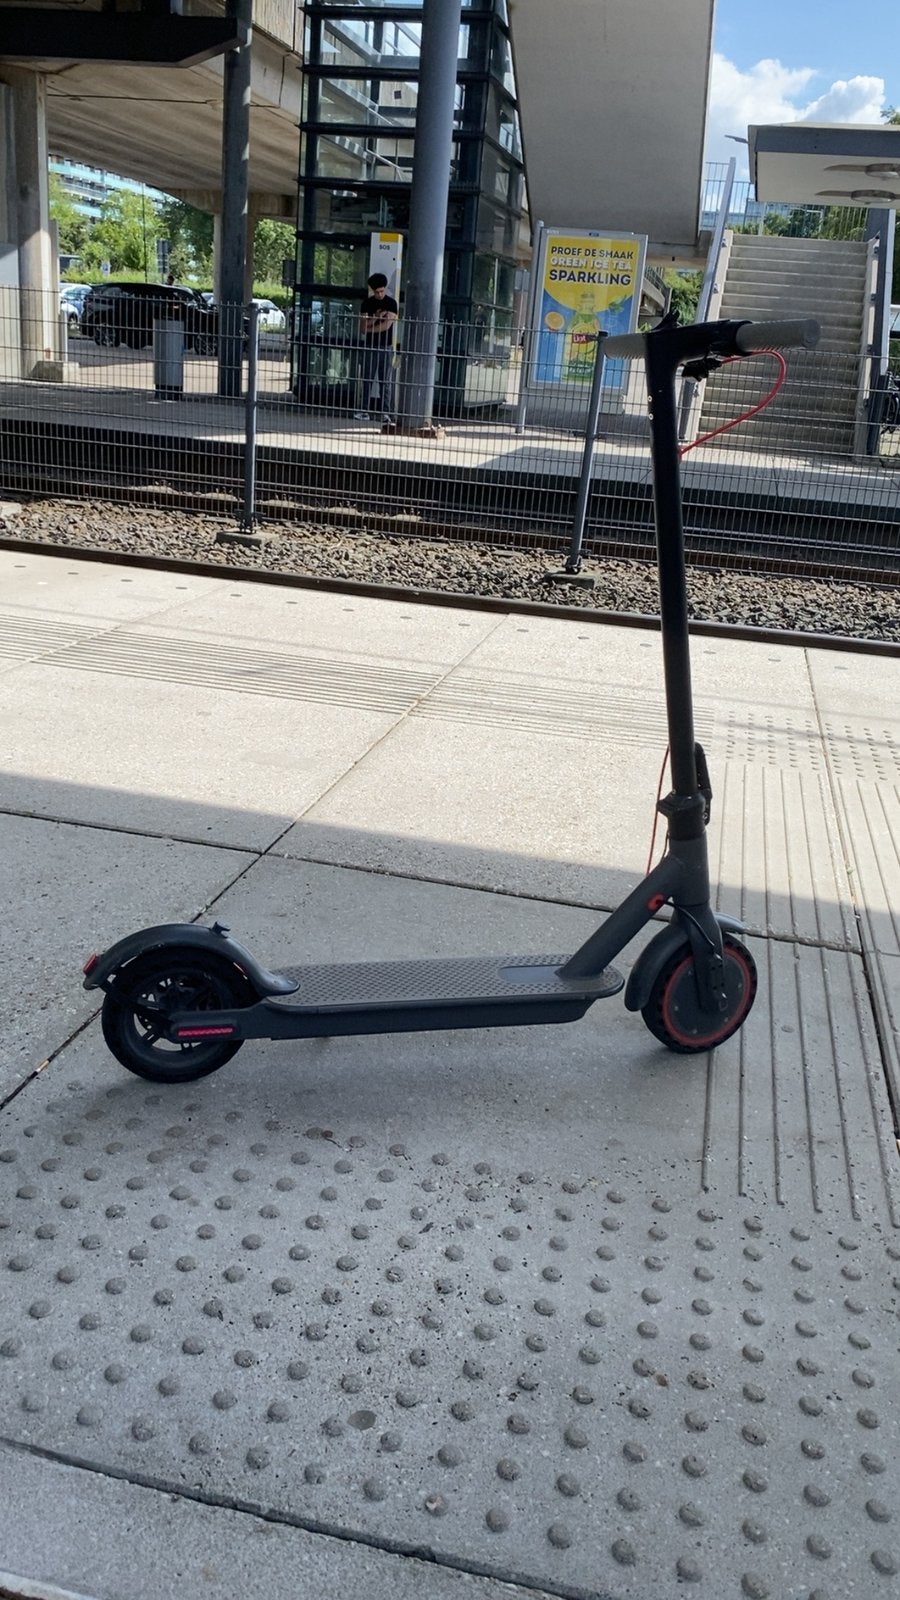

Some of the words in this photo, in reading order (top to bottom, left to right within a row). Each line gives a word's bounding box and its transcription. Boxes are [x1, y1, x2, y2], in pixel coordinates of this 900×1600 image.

[551, 246, 582, 256] PROEF
[584, 248, 597, 257] DE
[599, 249, 634, 259] SMAAK
[551, 256, 588, 269] GREEN
[590, 258, 609, 270] ICE
[612, 260, 633, 272] TEA
[549, 269, 631, 286] SPARKLING
